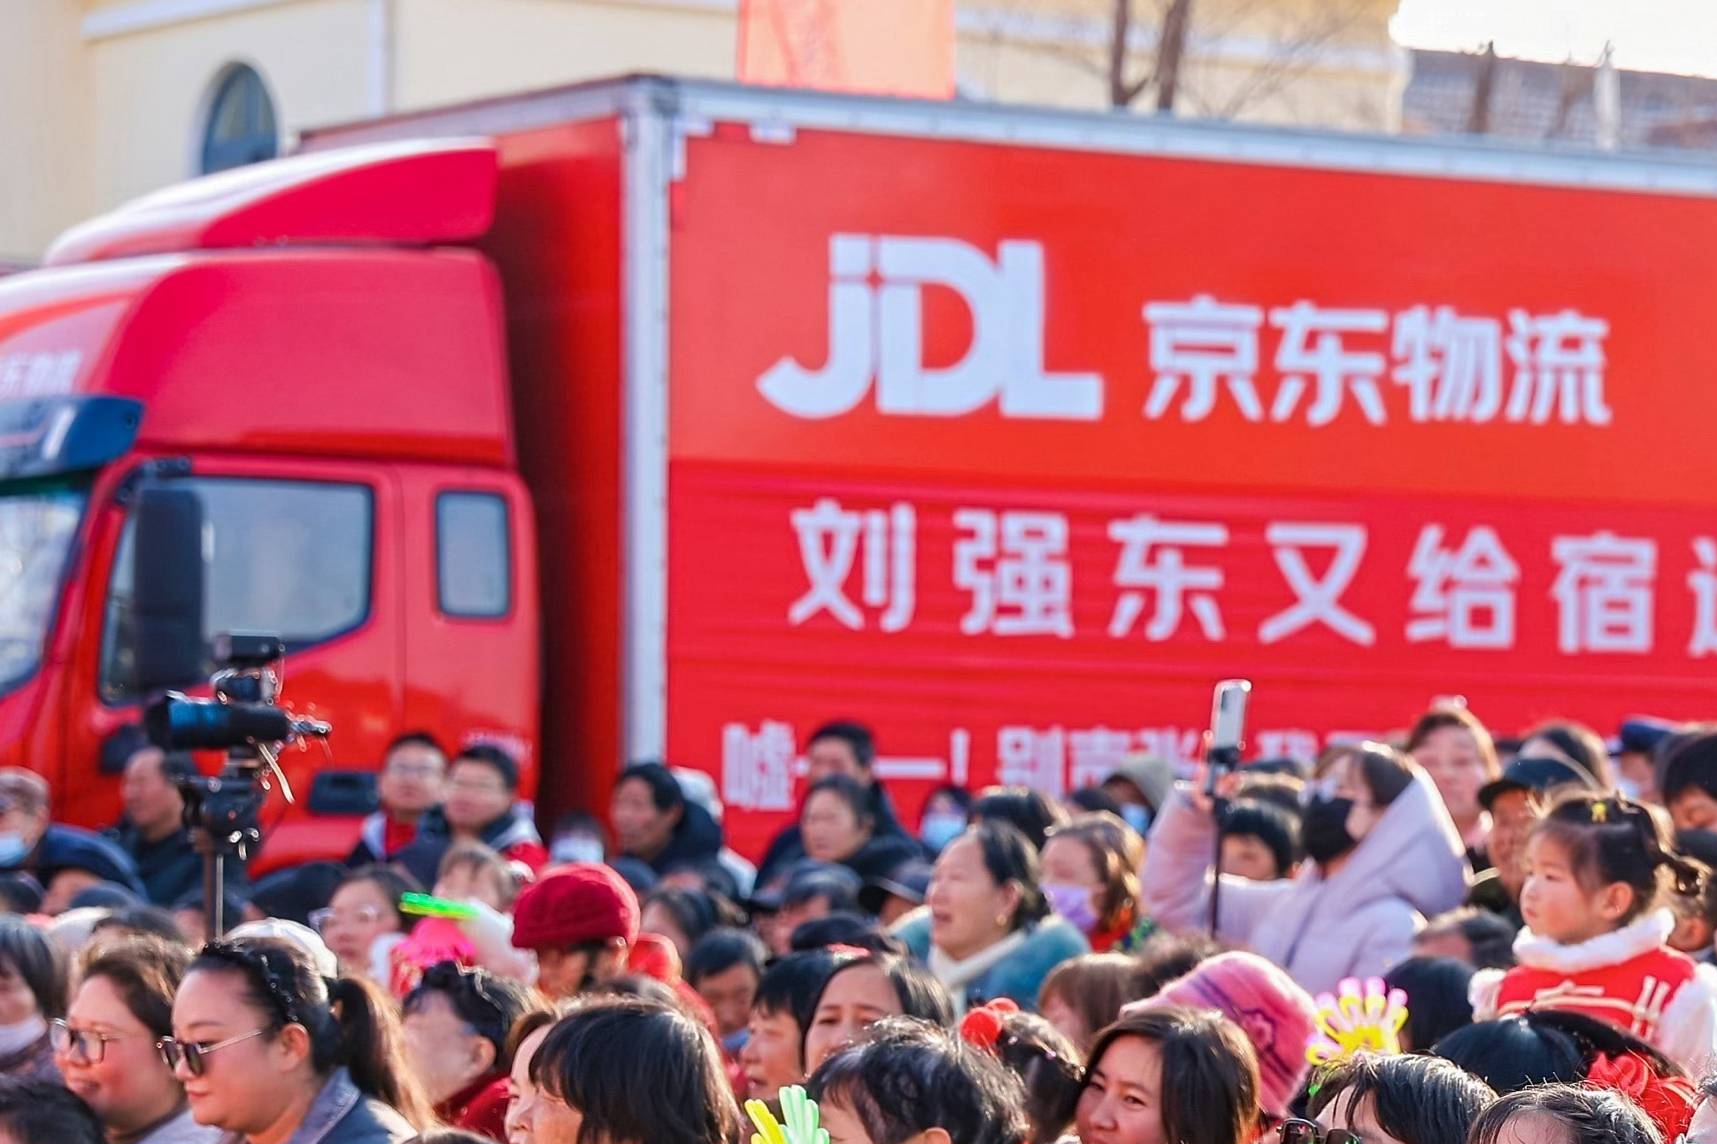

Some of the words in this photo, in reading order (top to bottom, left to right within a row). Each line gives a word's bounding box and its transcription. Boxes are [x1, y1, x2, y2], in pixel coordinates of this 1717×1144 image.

[756, 232, 1104, 420] JDL
[1142, 294, 1613, 427] 京东物流
